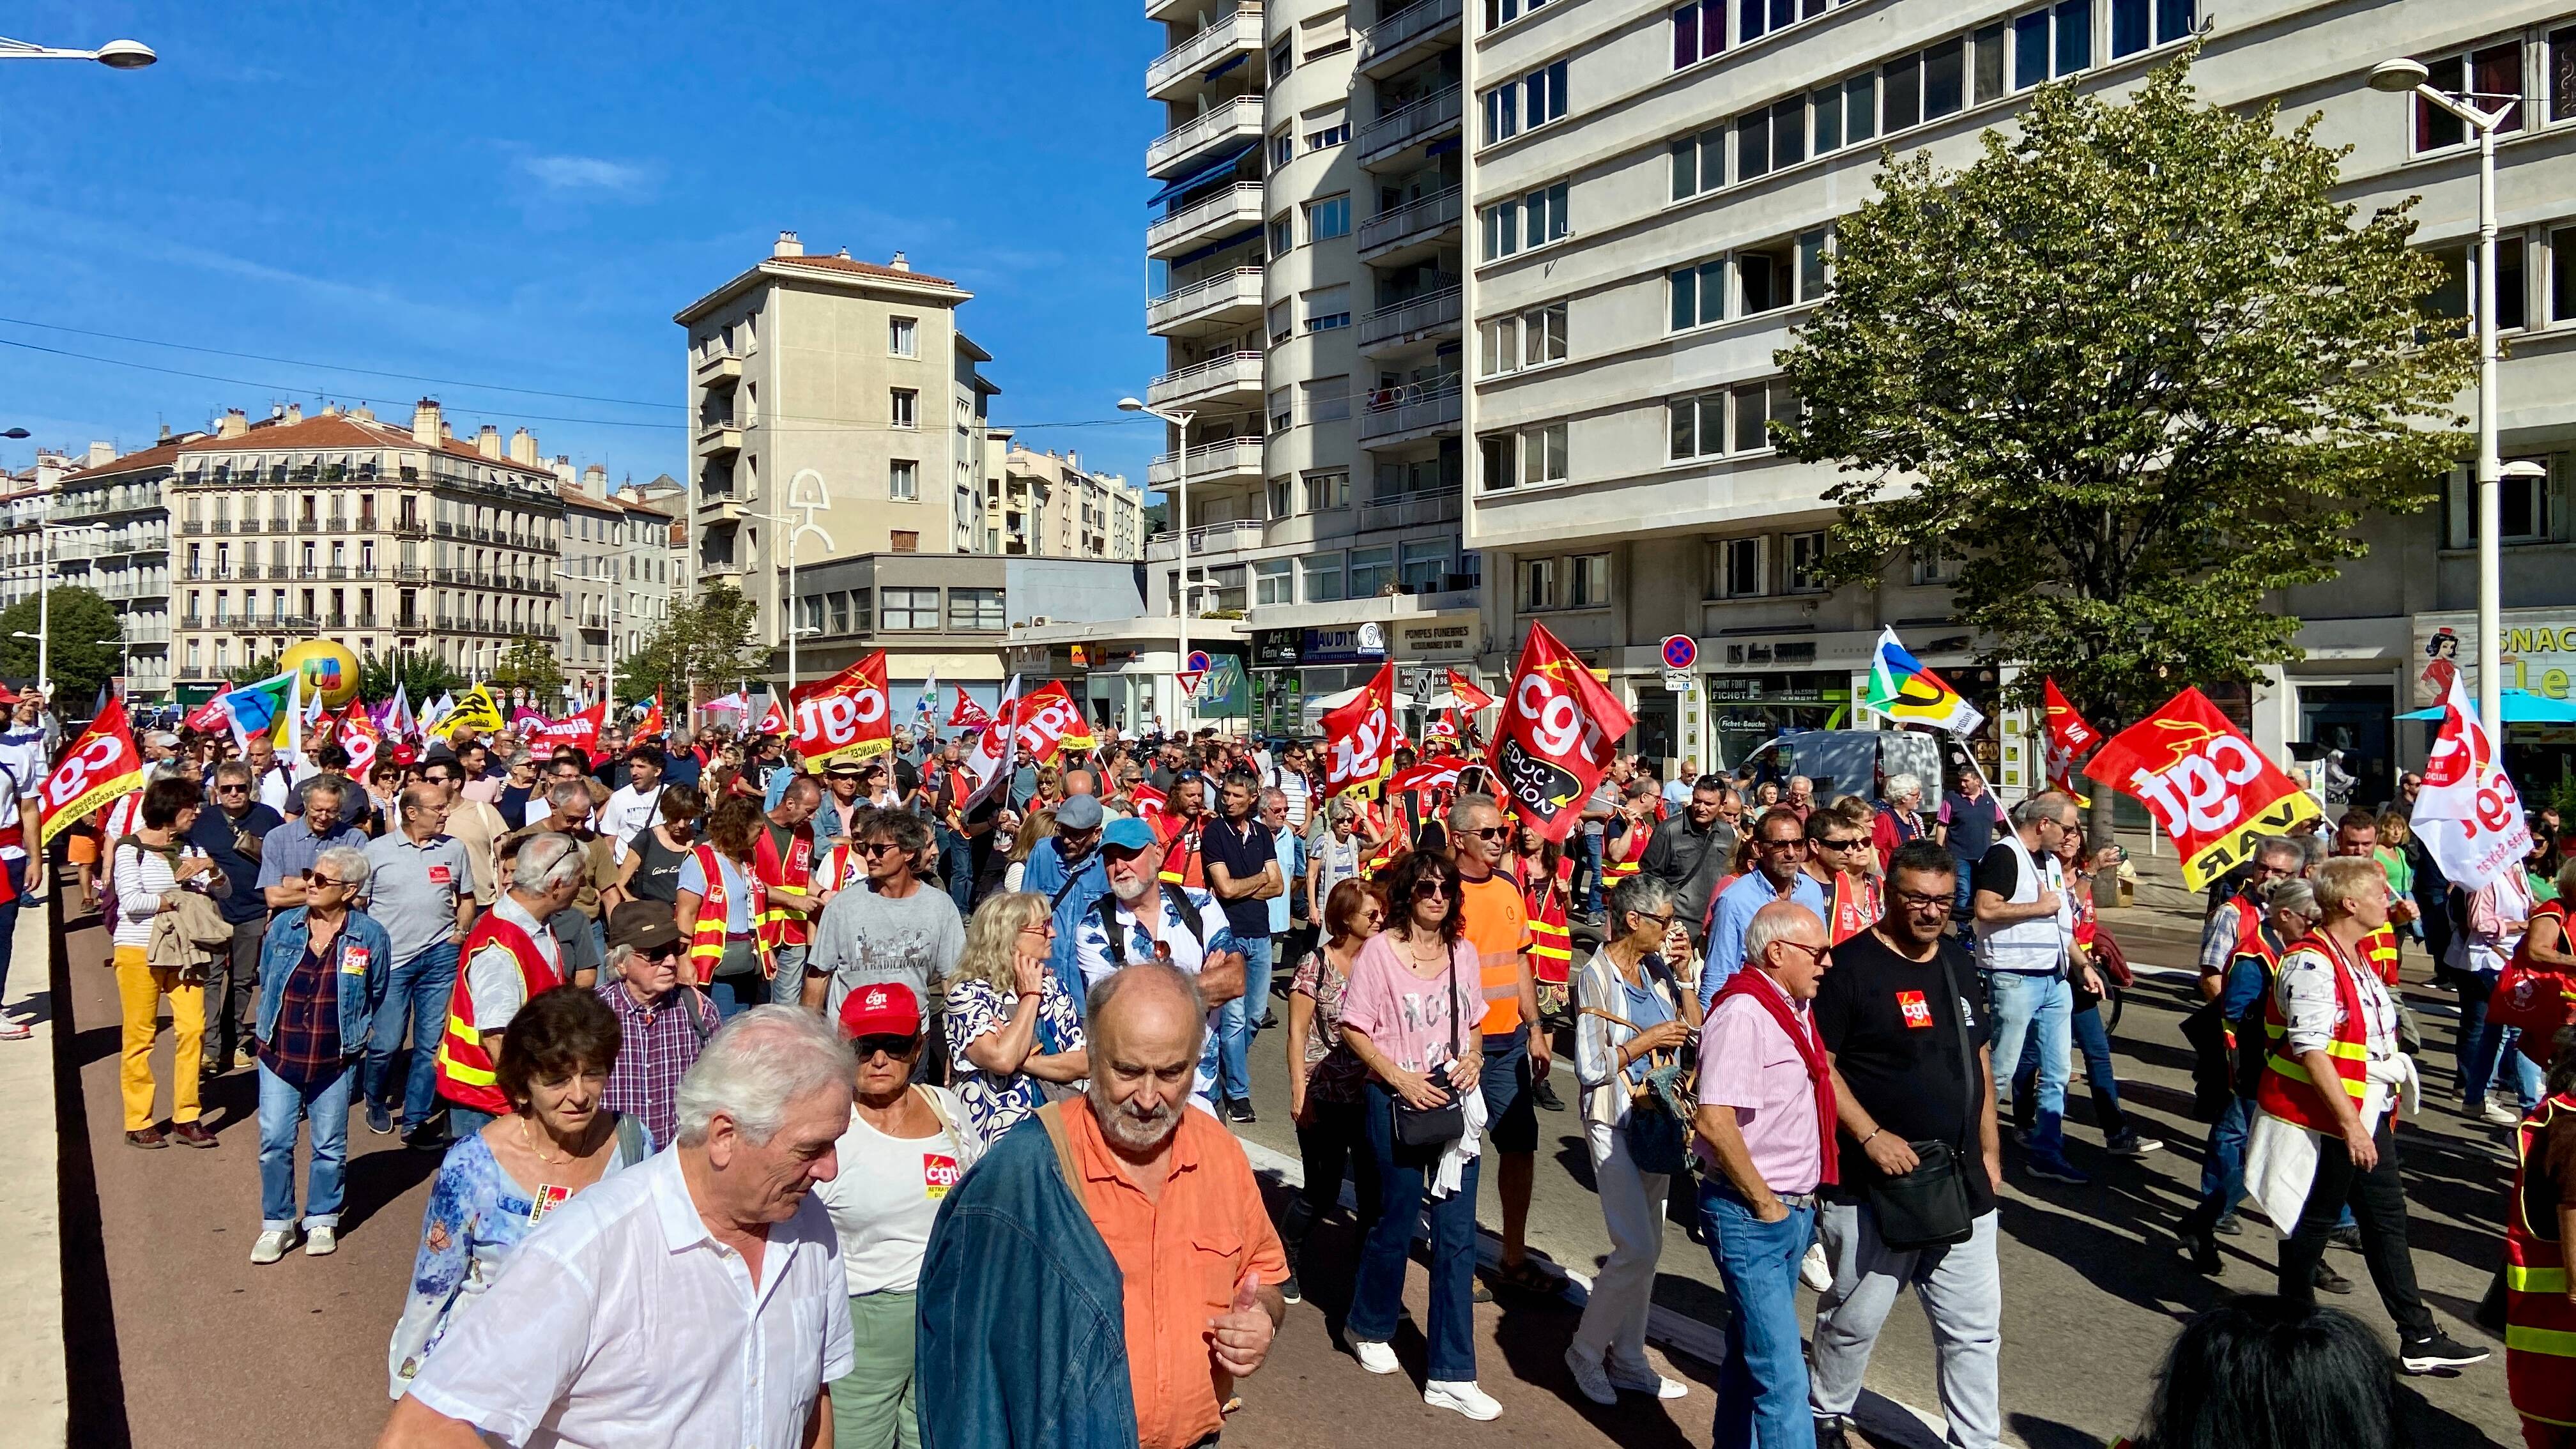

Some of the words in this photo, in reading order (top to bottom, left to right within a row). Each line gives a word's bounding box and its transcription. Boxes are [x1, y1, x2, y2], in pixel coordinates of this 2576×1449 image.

[1268, 632, 1282, 644] Art
[1405, 629, 1432, 639] POMPES
[1434, 626, 1468, 638] FUNEBRES
[1029, 646, 1046, 662] Var
[1712, 679, 1731, 689] POINT
[1732, 678, 1746, 689] FORT
[2515, 660, 2570, 700] Le
[344, 954, 368, 967] cgt
[866, 993, 887, 1006] cgt
[1901, 999, 1930, 1020] cgt
[926, 1165, 960, 1185] cgt
